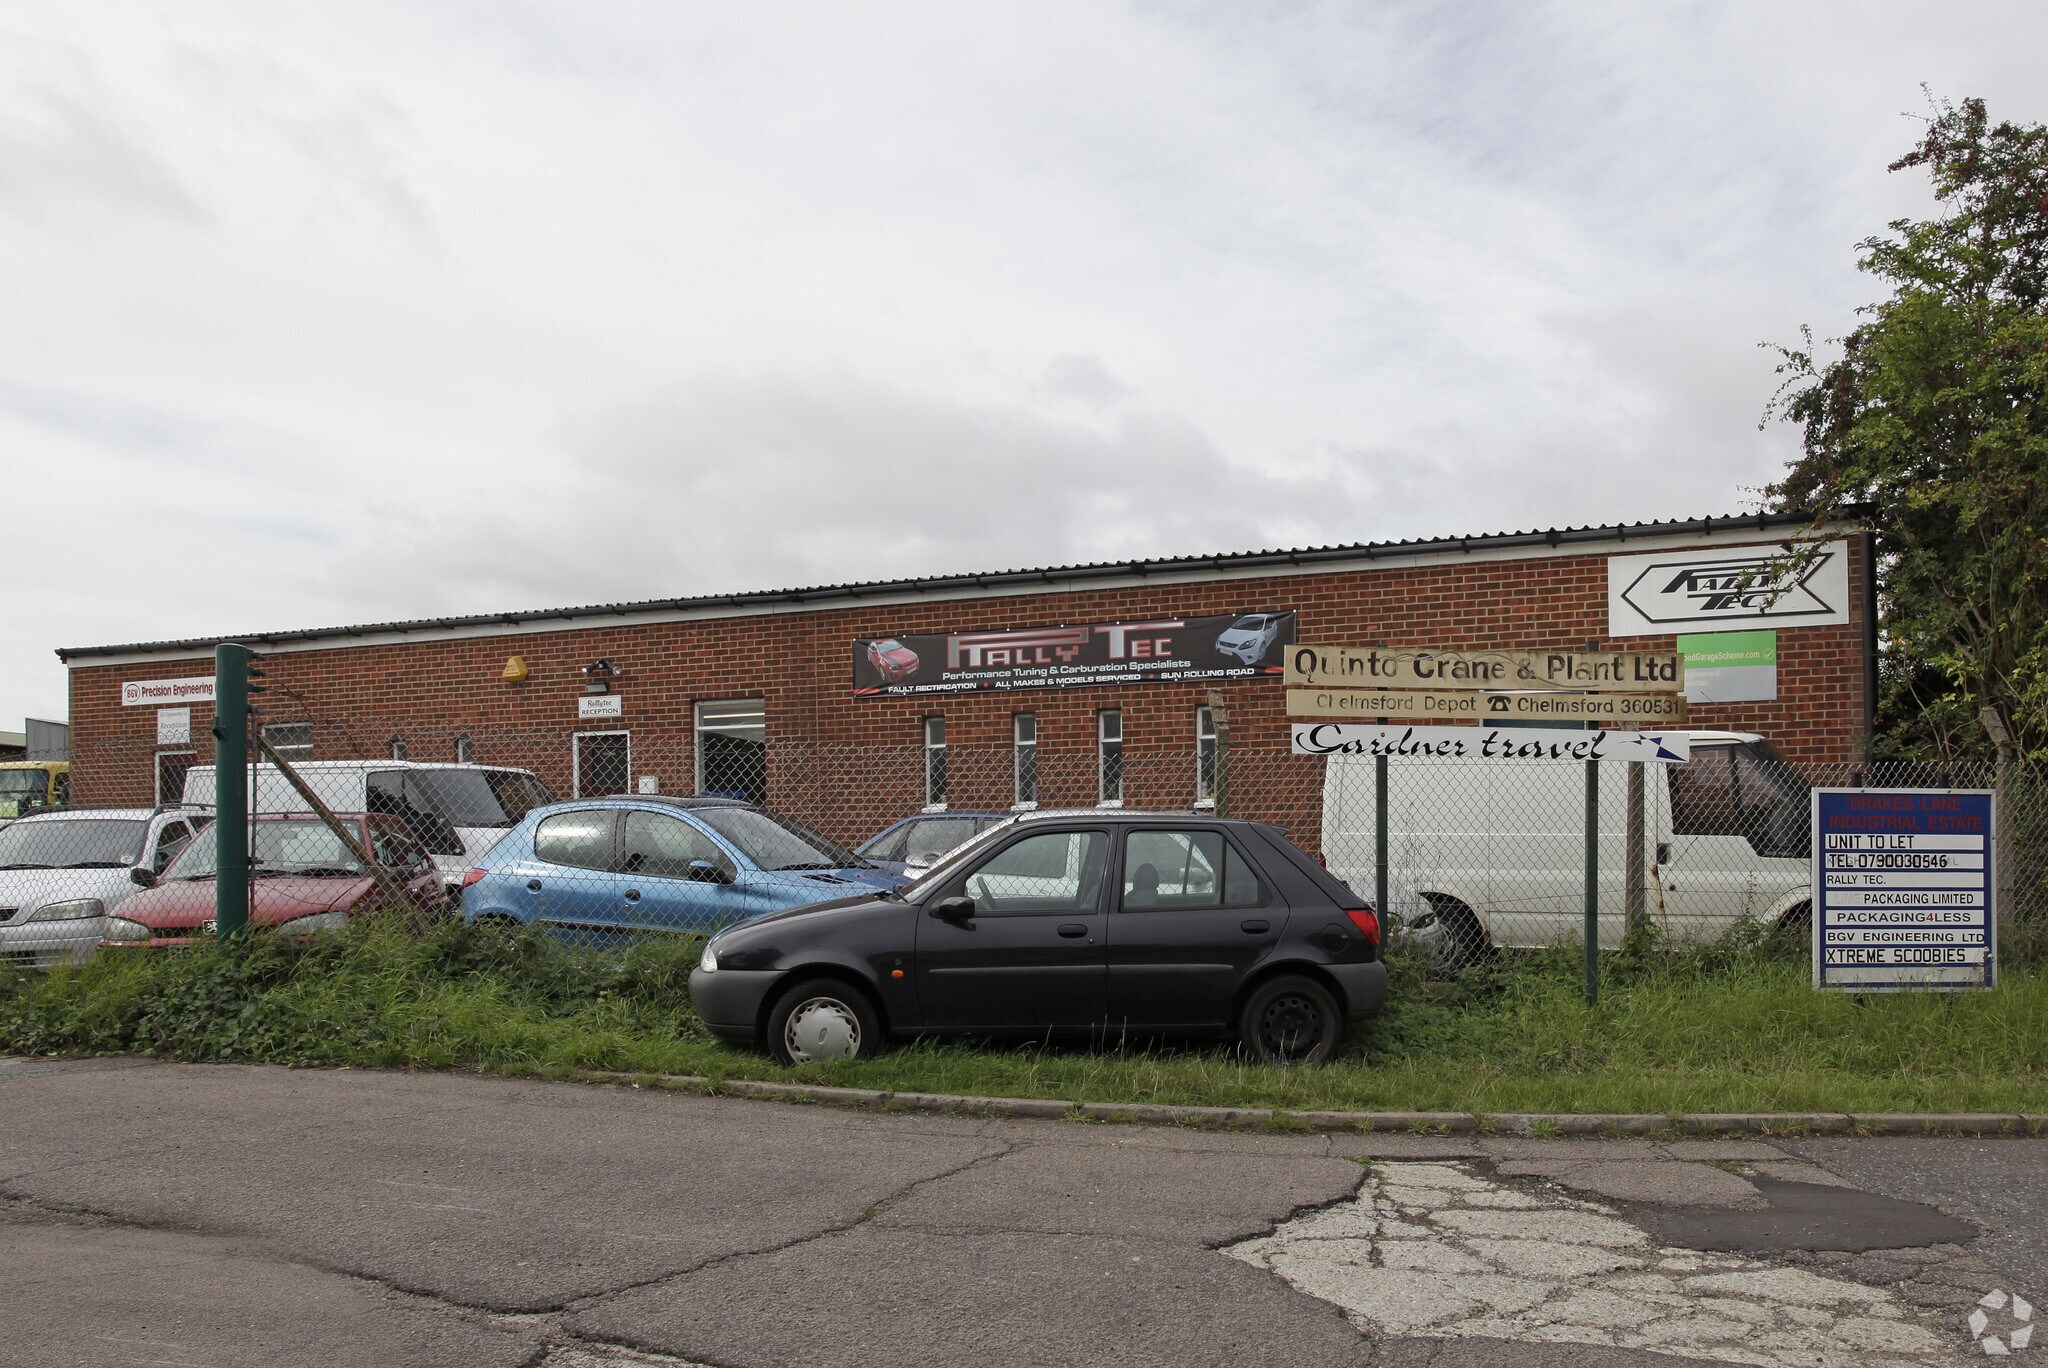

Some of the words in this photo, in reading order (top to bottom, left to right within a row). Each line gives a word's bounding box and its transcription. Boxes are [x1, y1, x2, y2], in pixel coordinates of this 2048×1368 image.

[947, 627, 1089, 669] RALLY
[1094, 621, 1185, 659] TEC
[1684, 651, 1760, 663] oodGarageScheme.com
[943, 669, 1011, 680] Performance
[1013, 667, 1048, 678] Tuning
[1049, 666, 1058, 675] &
[1060, 663, 1127, 674] Carburation
[1129, 660, 1191, 671] Specialists
[1294, 648, 1398, 683] Quinto
[1413, 652, 1506, 680] Crane
[1517, 657, 1537, 680] &
[1547, 655, 1625, 682] Plant
[1634, 656, 1677, 682] Ltd
[916, 682, 977, 692] RECTIFICATION
[995, 680, 1012, 688] ALL
[1013, 678, 1046, 687] MAKES
[1056, 676, 1094, 685] MODELS
[1096, 674, 1141, 683] SERVICED
[1161, 671, 1181, 679] SUN
[1184, 669, 1224, 678] ROLLING
[1226, 668, 1255, 676] ROAD
[142, 685, 172, 698] Precision
[173, 682, 213, 697] Engineering
[582, 708, 619, 716] RECEPTION
[1424, 696, 1476, 713] Depot
[1517, 697, 1614, 714] Chelmsford
[1620, 699, 1680, 715] 360531
[160, 721, 188, 730] Reception
[1481, 730, 1607, 760] travel
[1849, 796, 1914, 811] DRAKES
[1921, 797, 1962, 811] LANE
[1829, 815, 1920, 830] INDUSTRIAL
[1928, 816, 1983, 830] ESTATE
[1828, 835, 1862, 849] UNIT
[1867, 835, 1885, 849] TO
[1889, 835, 1914, 849] LET
[1829, 854, 1854, 868] TEL
[1858, 854, 1948, 868] 0790030546
[1827, 874, 1858, 885] RALLY
[1863, 874, 1887, 885] TEC.
[1864, 893, 1929, 904] PACKAGING
[1932, 893, 1974, 904] LIMITED
[1837, 912, 1971, 923] PACKAGING4LESS
[1827, 932, 1855, 942] BGV
[1863, 932, 1954, 942] ENGINEERING
[1962, 933, 1985, 943] LTD
[1826, 949, 1886, 963] XTREME
[1894, 948, 1965, 962] SCOOBIES
